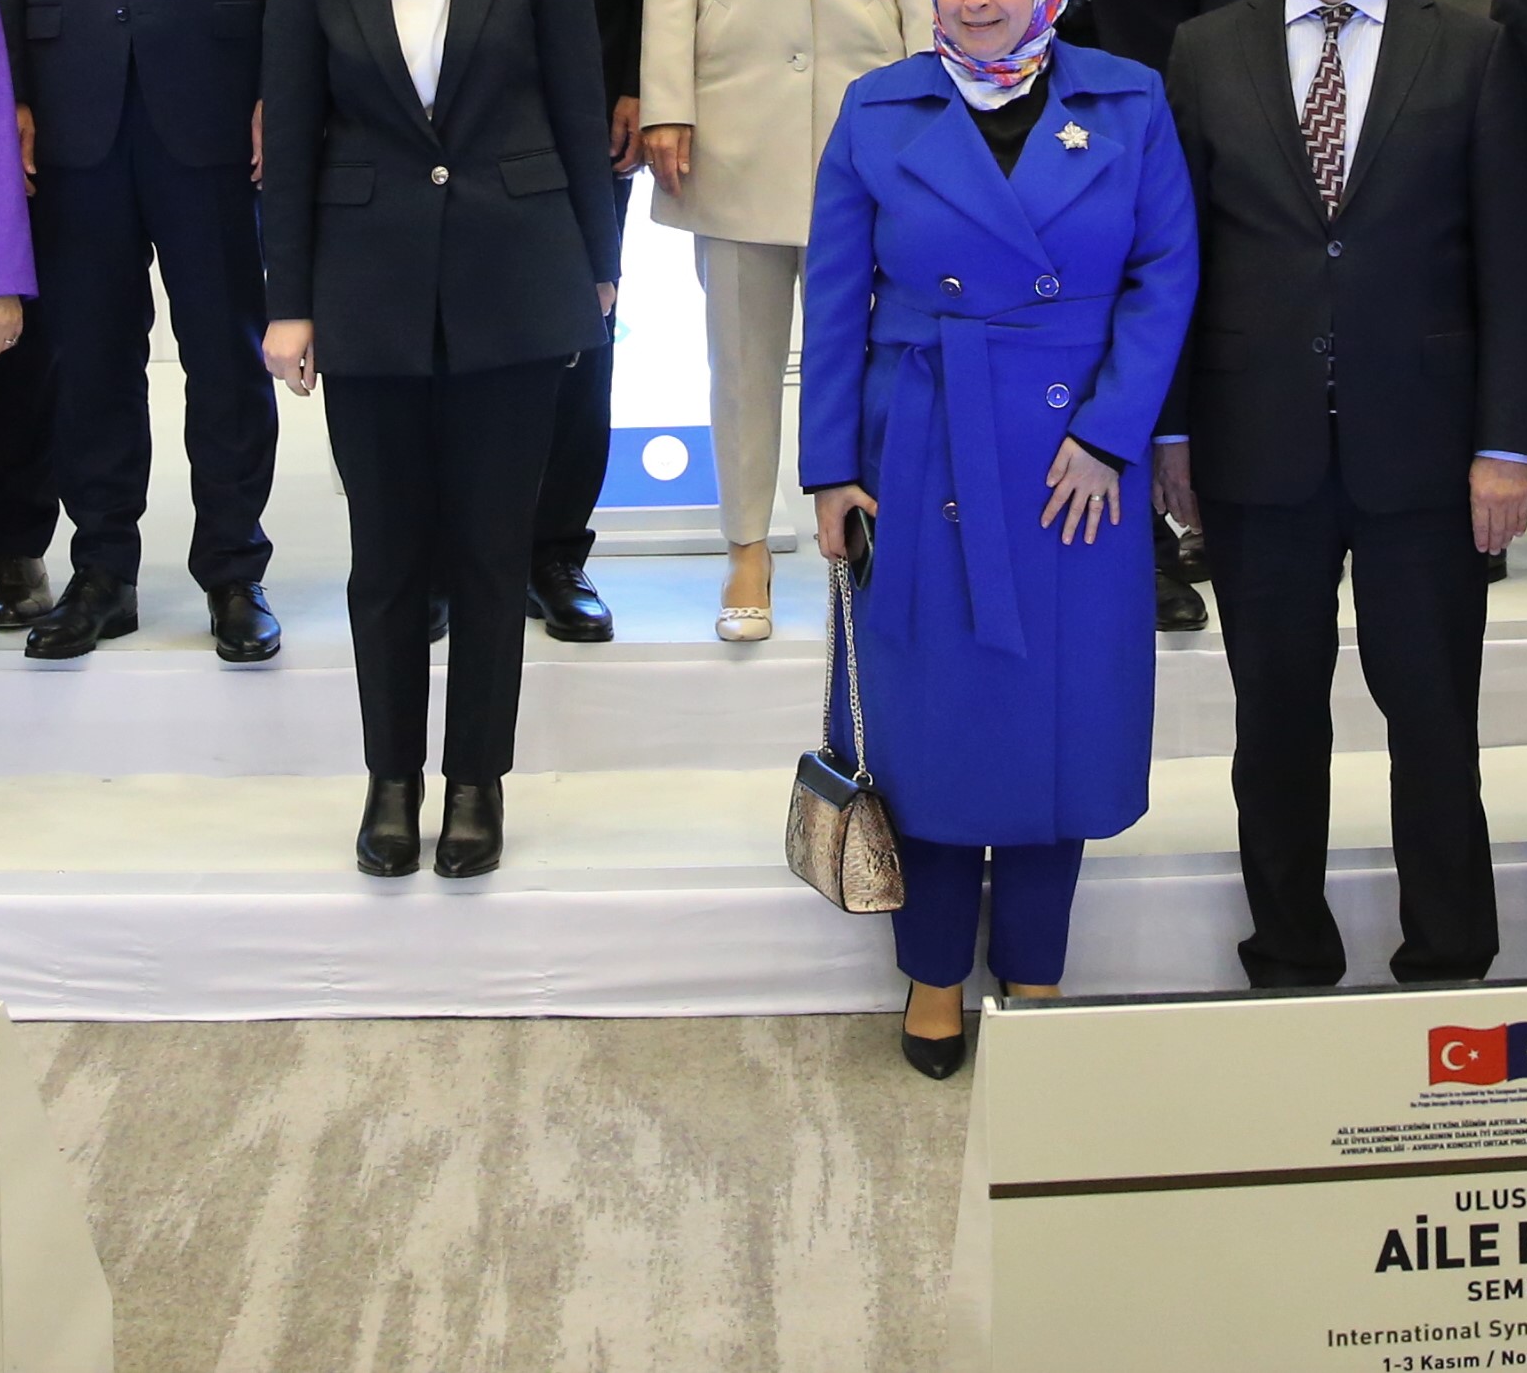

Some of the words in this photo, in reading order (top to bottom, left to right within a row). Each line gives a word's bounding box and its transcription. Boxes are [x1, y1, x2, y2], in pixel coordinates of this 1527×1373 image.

[1375, 1215, 1499, 1273] AİLE
[1329, 1322, 1480, 1347] International
[1384, 1357, 1413, 1372] 1-3
[1421, 1356, 1479, 1370] Kasım
